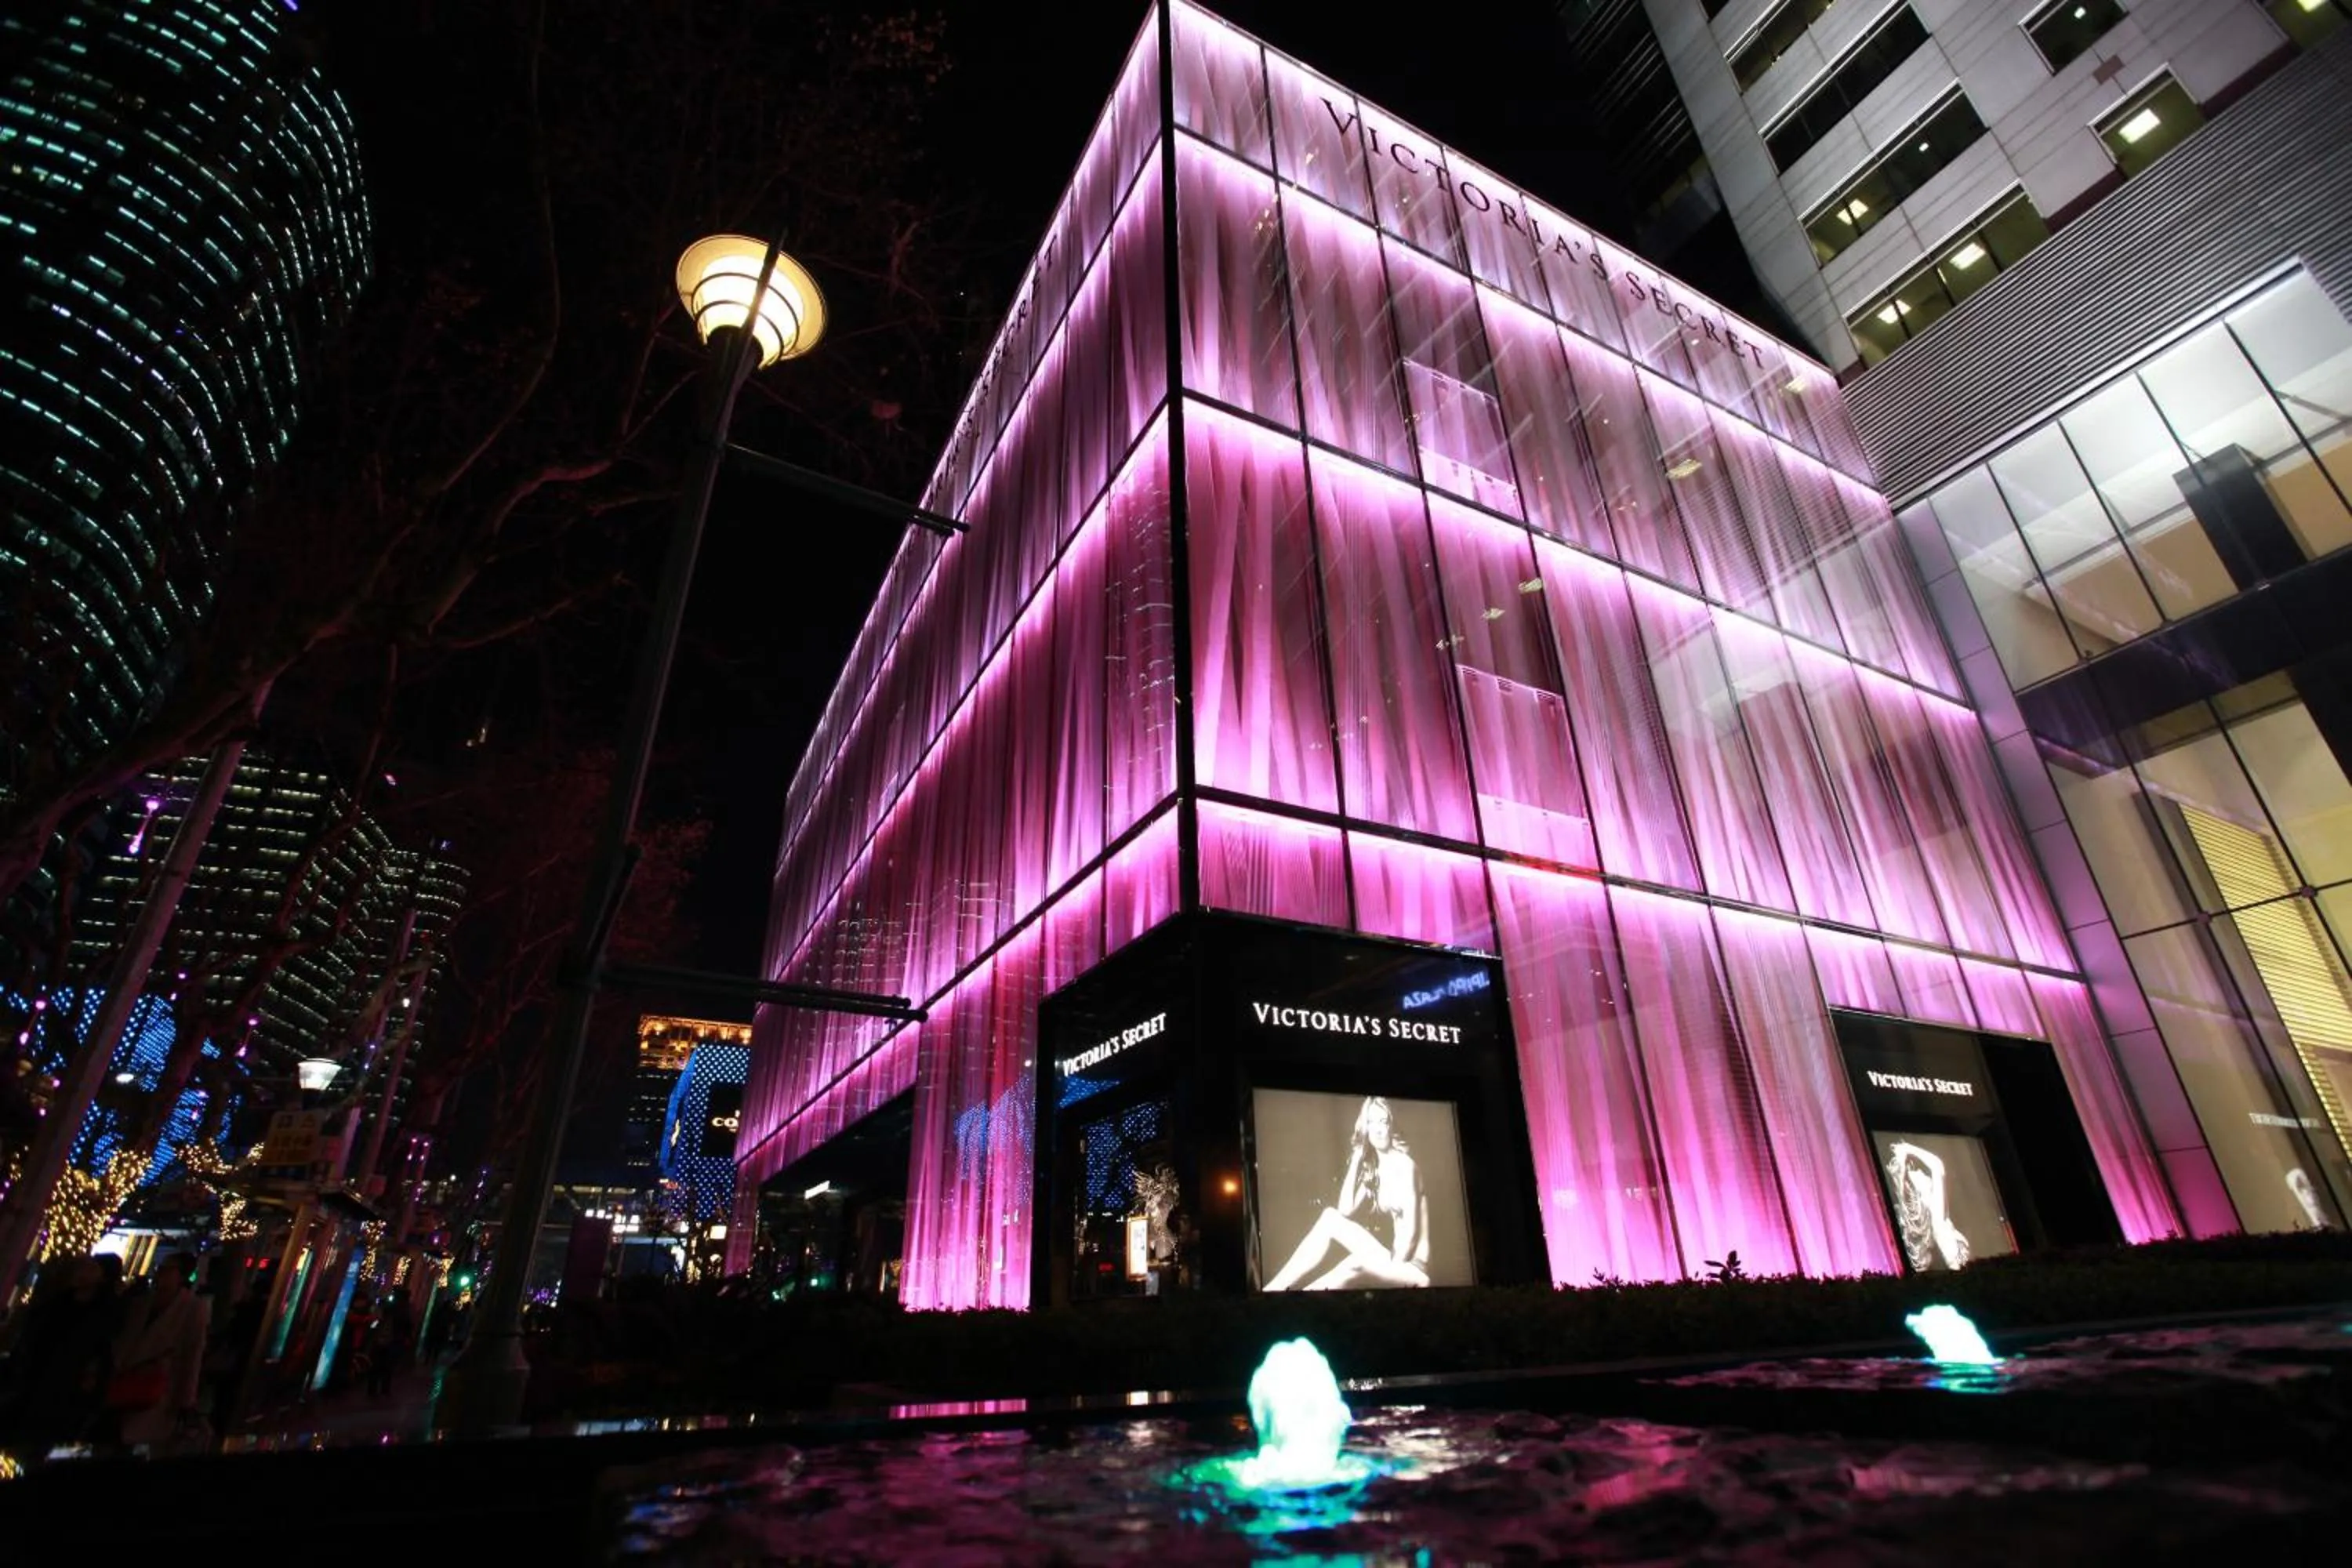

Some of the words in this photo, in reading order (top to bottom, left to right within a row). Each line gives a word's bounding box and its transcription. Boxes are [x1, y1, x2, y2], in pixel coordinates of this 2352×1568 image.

[1319, 96, 1609, 281] VICTORIA'S
[1625, 270, 1764, 370] SECRET
[1062, 1036, 1120, 1077] VICTORIA'S
[1122, 1012, 1167, 1050] SECRET
[1253, 1002, 1381, 1036] VICTORIA'S
[1388, 1018, 1461, 1044] SECRET
[1867, 1070, 1933, 1092] VICTORIA'S
[1933, 1078, 1973, 1096] SECRET
